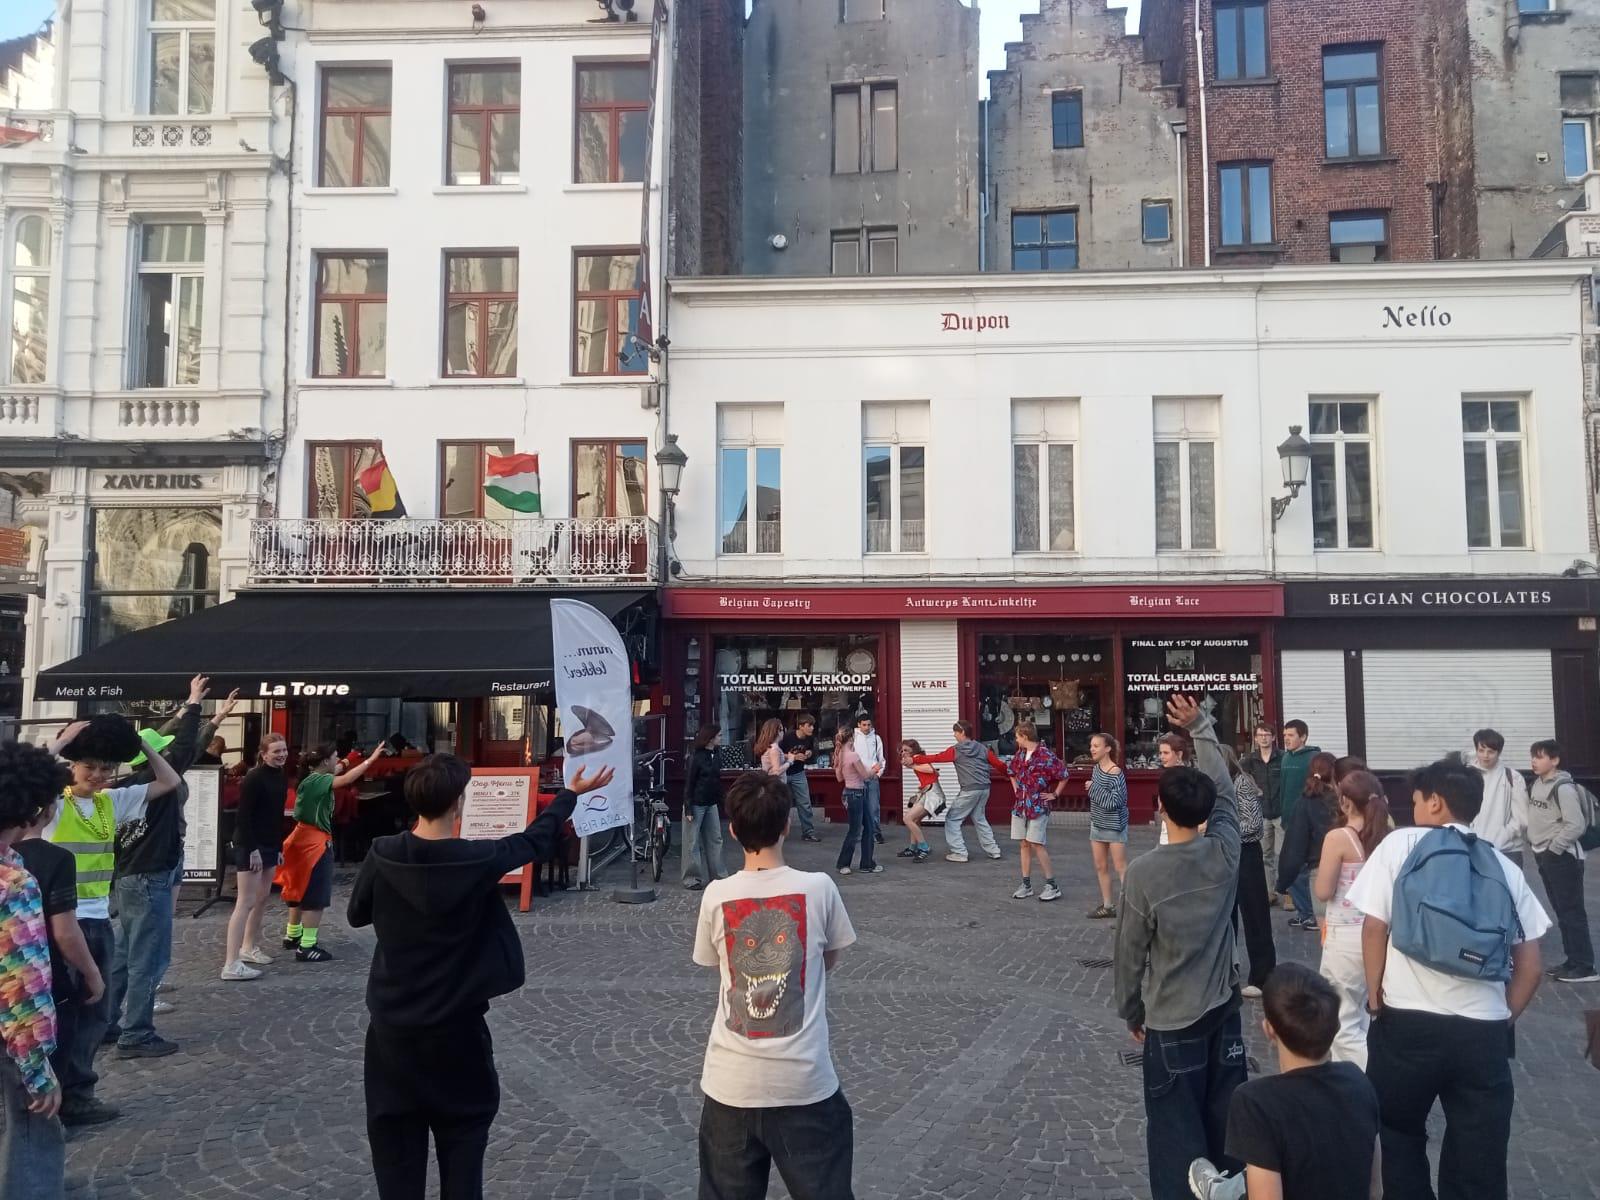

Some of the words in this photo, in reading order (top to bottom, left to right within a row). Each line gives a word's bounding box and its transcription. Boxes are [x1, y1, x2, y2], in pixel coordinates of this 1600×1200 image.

[941, 312, 1010, 333] Dupon
[1382, 306, 1452, 329] Nello
[103, 474, 203, 490] XAVERIUS
[719, 596, 759, 609] Belgian
[762, 596, 811, 609] Tapestry
[904, 596, 958, 609] Antwerps
[1128, 595, 1172, 608] Belgian
[1329, 592, 1414, 606] BELGIAN
[1421, 591, 1552, 605] CHOCOLATES
[1131, 639, 1156, 648] FINAL
[1157, 639, 1174, 648] DAY
[1190, 639, 1202, 647] OF
[1203, 638, 1249, 648] AUGUSTUS
[720, 674, 775, 685] TOTALE
[778, 674, 871, 685] UITVERKOOP
[911, 680, 927, 688] WE
[929, 680, 948, 688] ARE
[1127, 673, 1162, 682] TOTAL
[1163, 673, 1228, 682] CLEARANCE
[1229, 673, 1257, 682] SALE
[56, 685, 84, 696] Meat
[87, 686, 97, 696] &
[100, 685, 123, 696] Fish
[259, 682, 288, 697] La
[291, 681, 350, 697] Torre
[491, 680, 550, 693] Restaurant
[1127, 683, 1179, 692] ANTWERP'S
[1182, 683, 1205, 692] LAST
[1207, 683, 1232, 692] LACE
[1233, 683, 1259, 692] SHOP
[190, 870, 212, 878] TORRE
